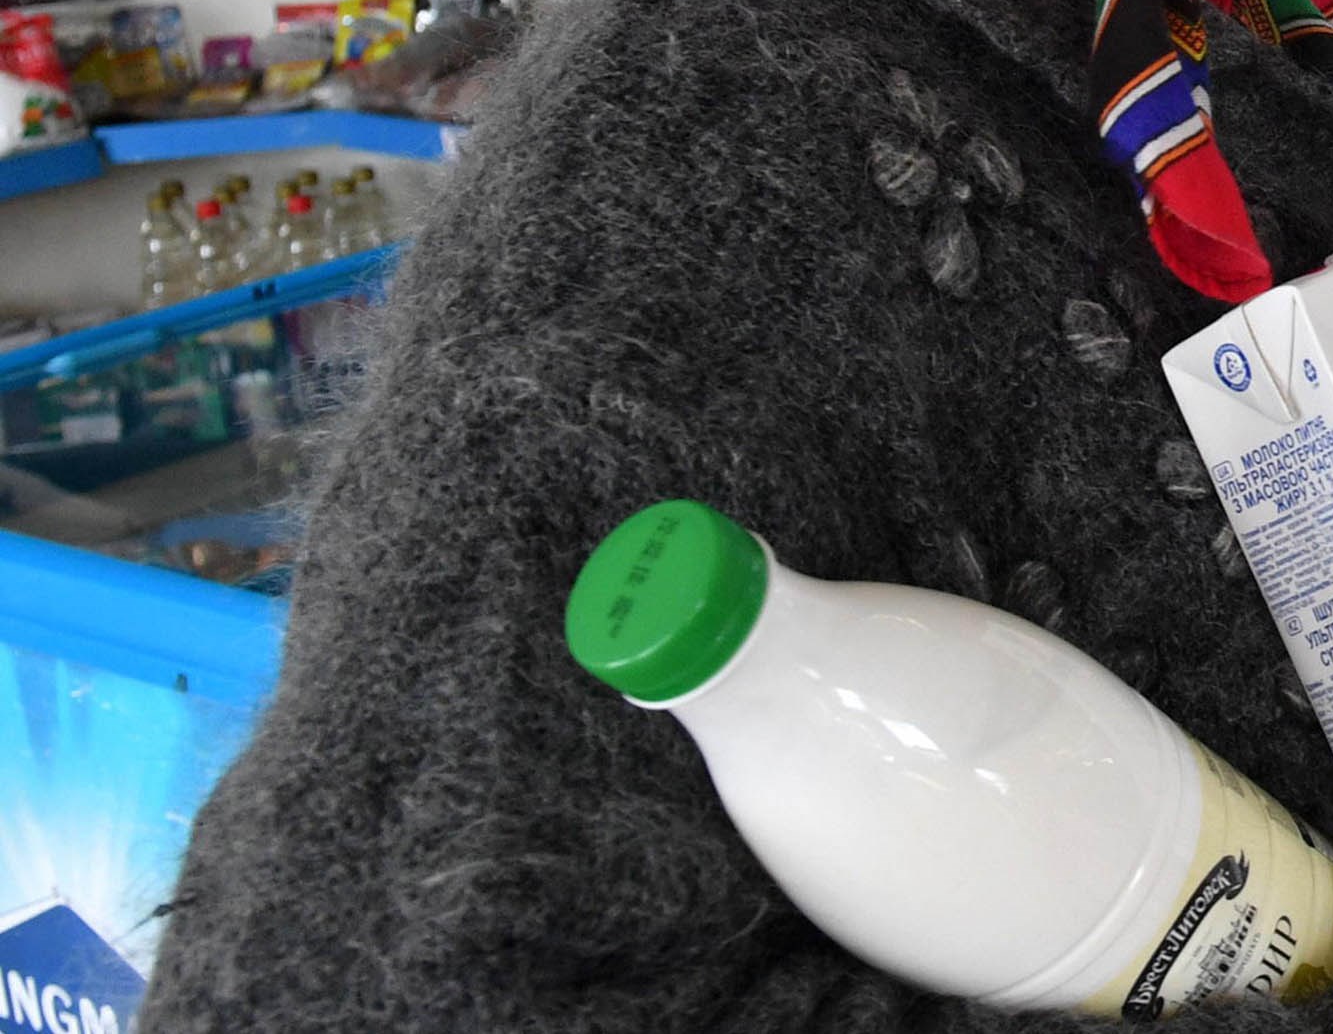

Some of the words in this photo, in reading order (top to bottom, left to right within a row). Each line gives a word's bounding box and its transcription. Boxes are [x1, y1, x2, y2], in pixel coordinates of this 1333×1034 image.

[1240, 429, 1294, 470] МОЛОКО
[1293, 415, 1327, 445] ПИТНЕ
[1243, 464, 1310, 510] МАСОВОЮ
[1272, 483, 1310, 514] ЖИРУ
